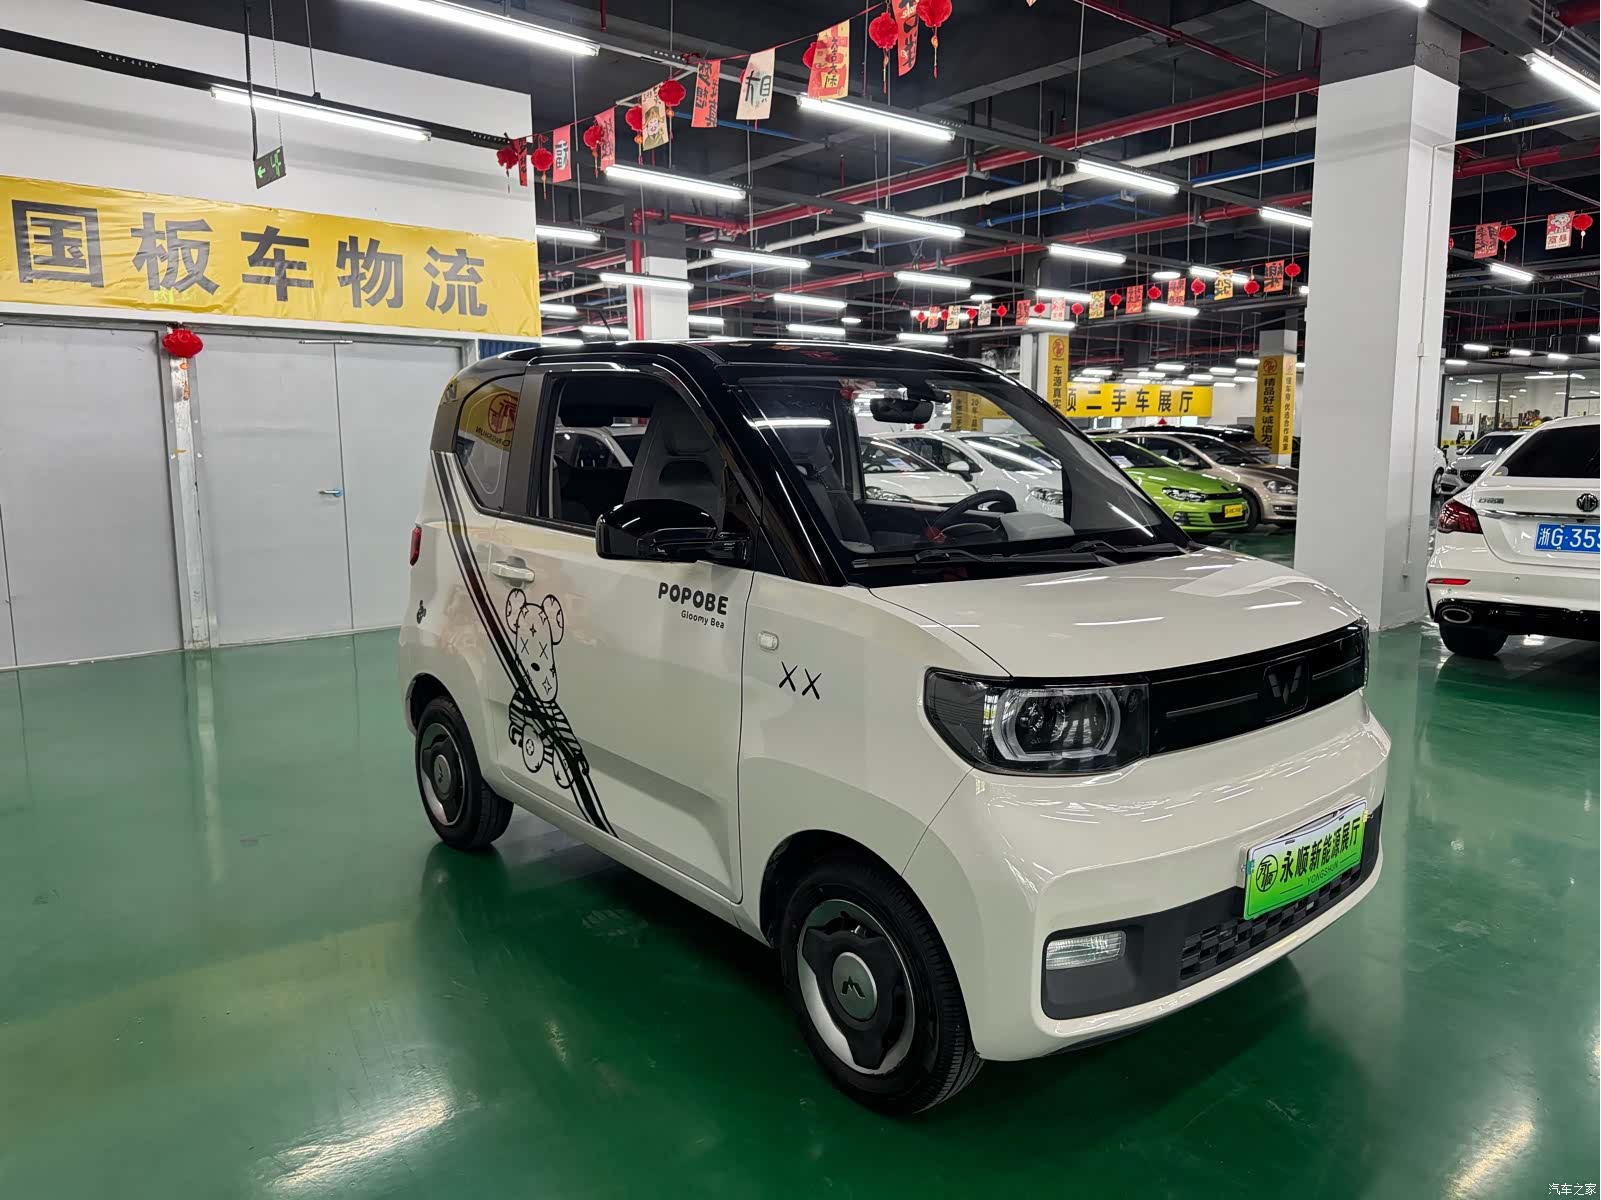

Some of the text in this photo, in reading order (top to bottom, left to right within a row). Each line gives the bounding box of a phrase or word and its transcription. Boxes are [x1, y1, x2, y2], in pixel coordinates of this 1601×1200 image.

[12, 199, 489, 317] 国板车物流
[1538, 527, 1600, 549] 浙G·35
[658, 581, 729, 616] POPOBE
[681, 609, 725, 629] Gloomy Bea
[1279, 816, 1361, 884] 永顺新能源展厅
